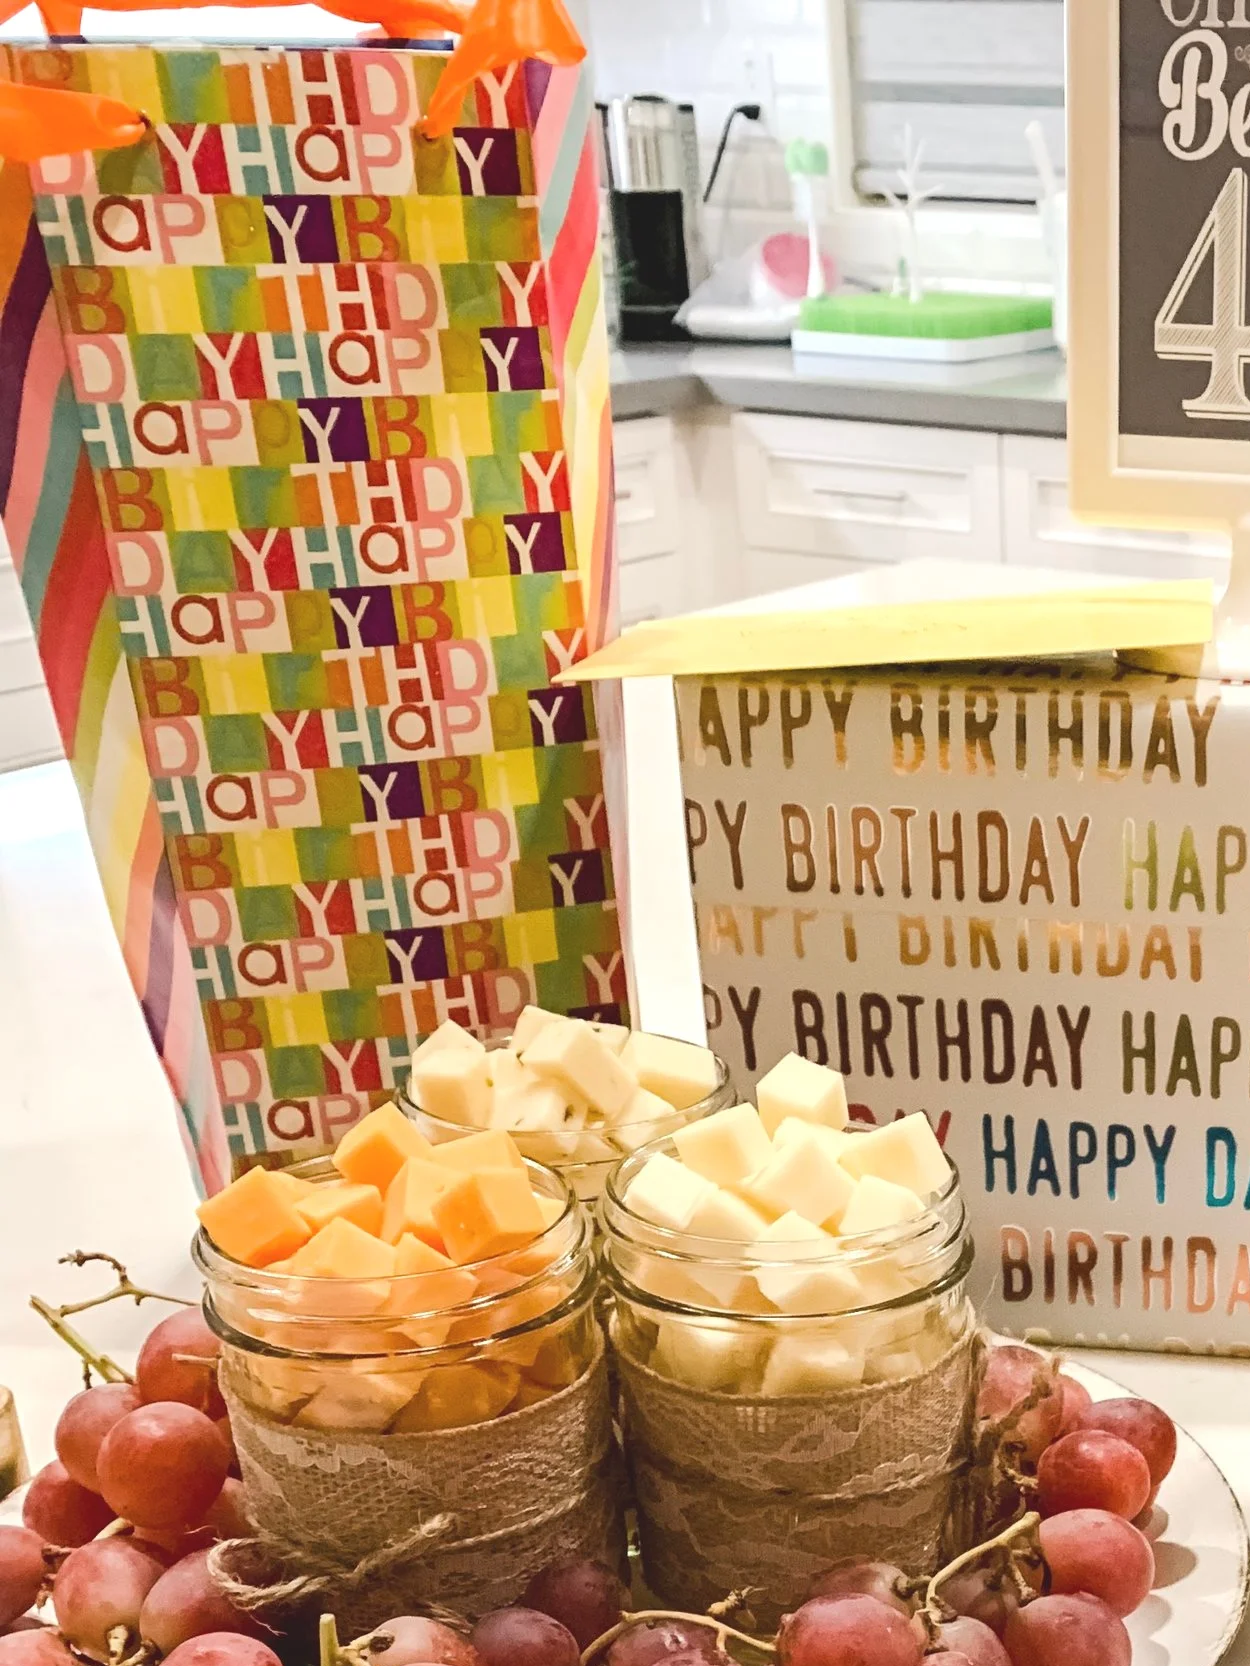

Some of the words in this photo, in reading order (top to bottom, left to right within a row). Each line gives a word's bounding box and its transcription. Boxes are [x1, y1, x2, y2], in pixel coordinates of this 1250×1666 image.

[221, 123, 494, 195] HaPY
[678, 676, 858, 770] APPY
[890, 682, 1221, 787] BIRTHDAY
[781, 803, 1090, 908] BIRTHDAY
[792, 989, 1091, 1090] BIRTHDAY
[982, 1113, 1176, 1205] HAPPY
